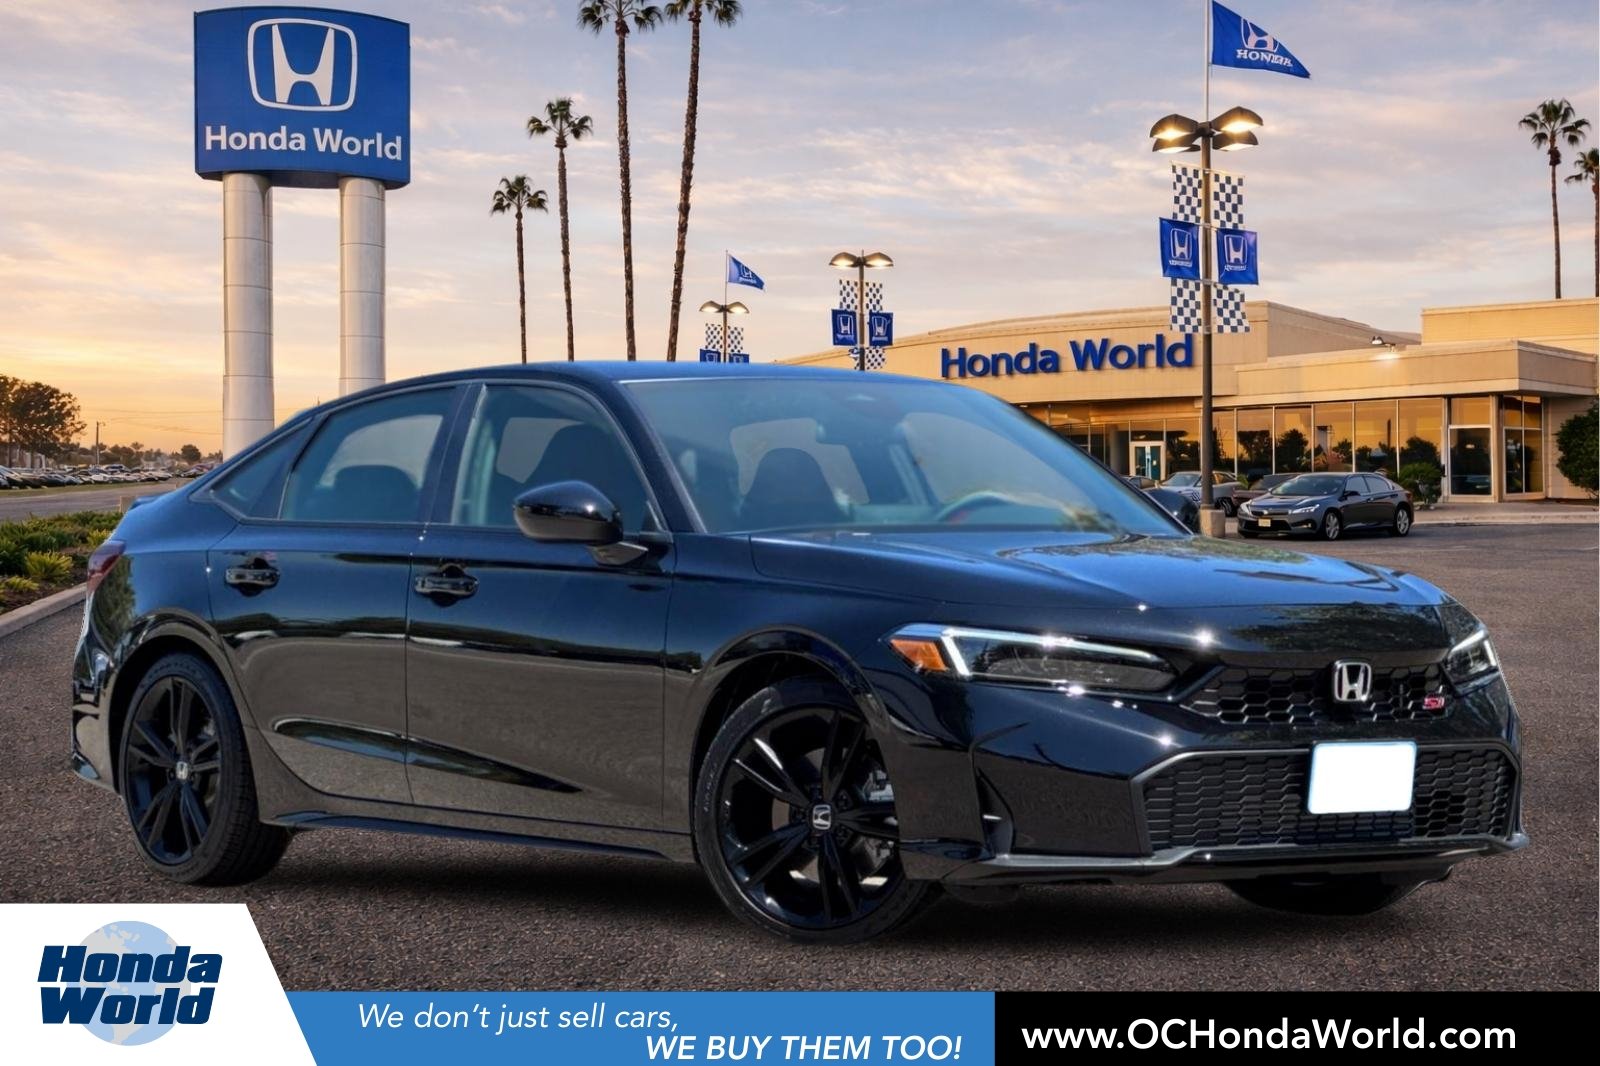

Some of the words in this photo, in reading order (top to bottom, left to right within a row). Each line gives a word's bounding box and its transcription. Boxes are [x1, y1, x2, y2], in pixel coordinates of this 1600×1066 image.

[205, 125, 306, 151] Honda
[313, 127, 402, 160] World
[941, 343, 1060, 378] Honda
[1070, 333, 1194, 371] World
